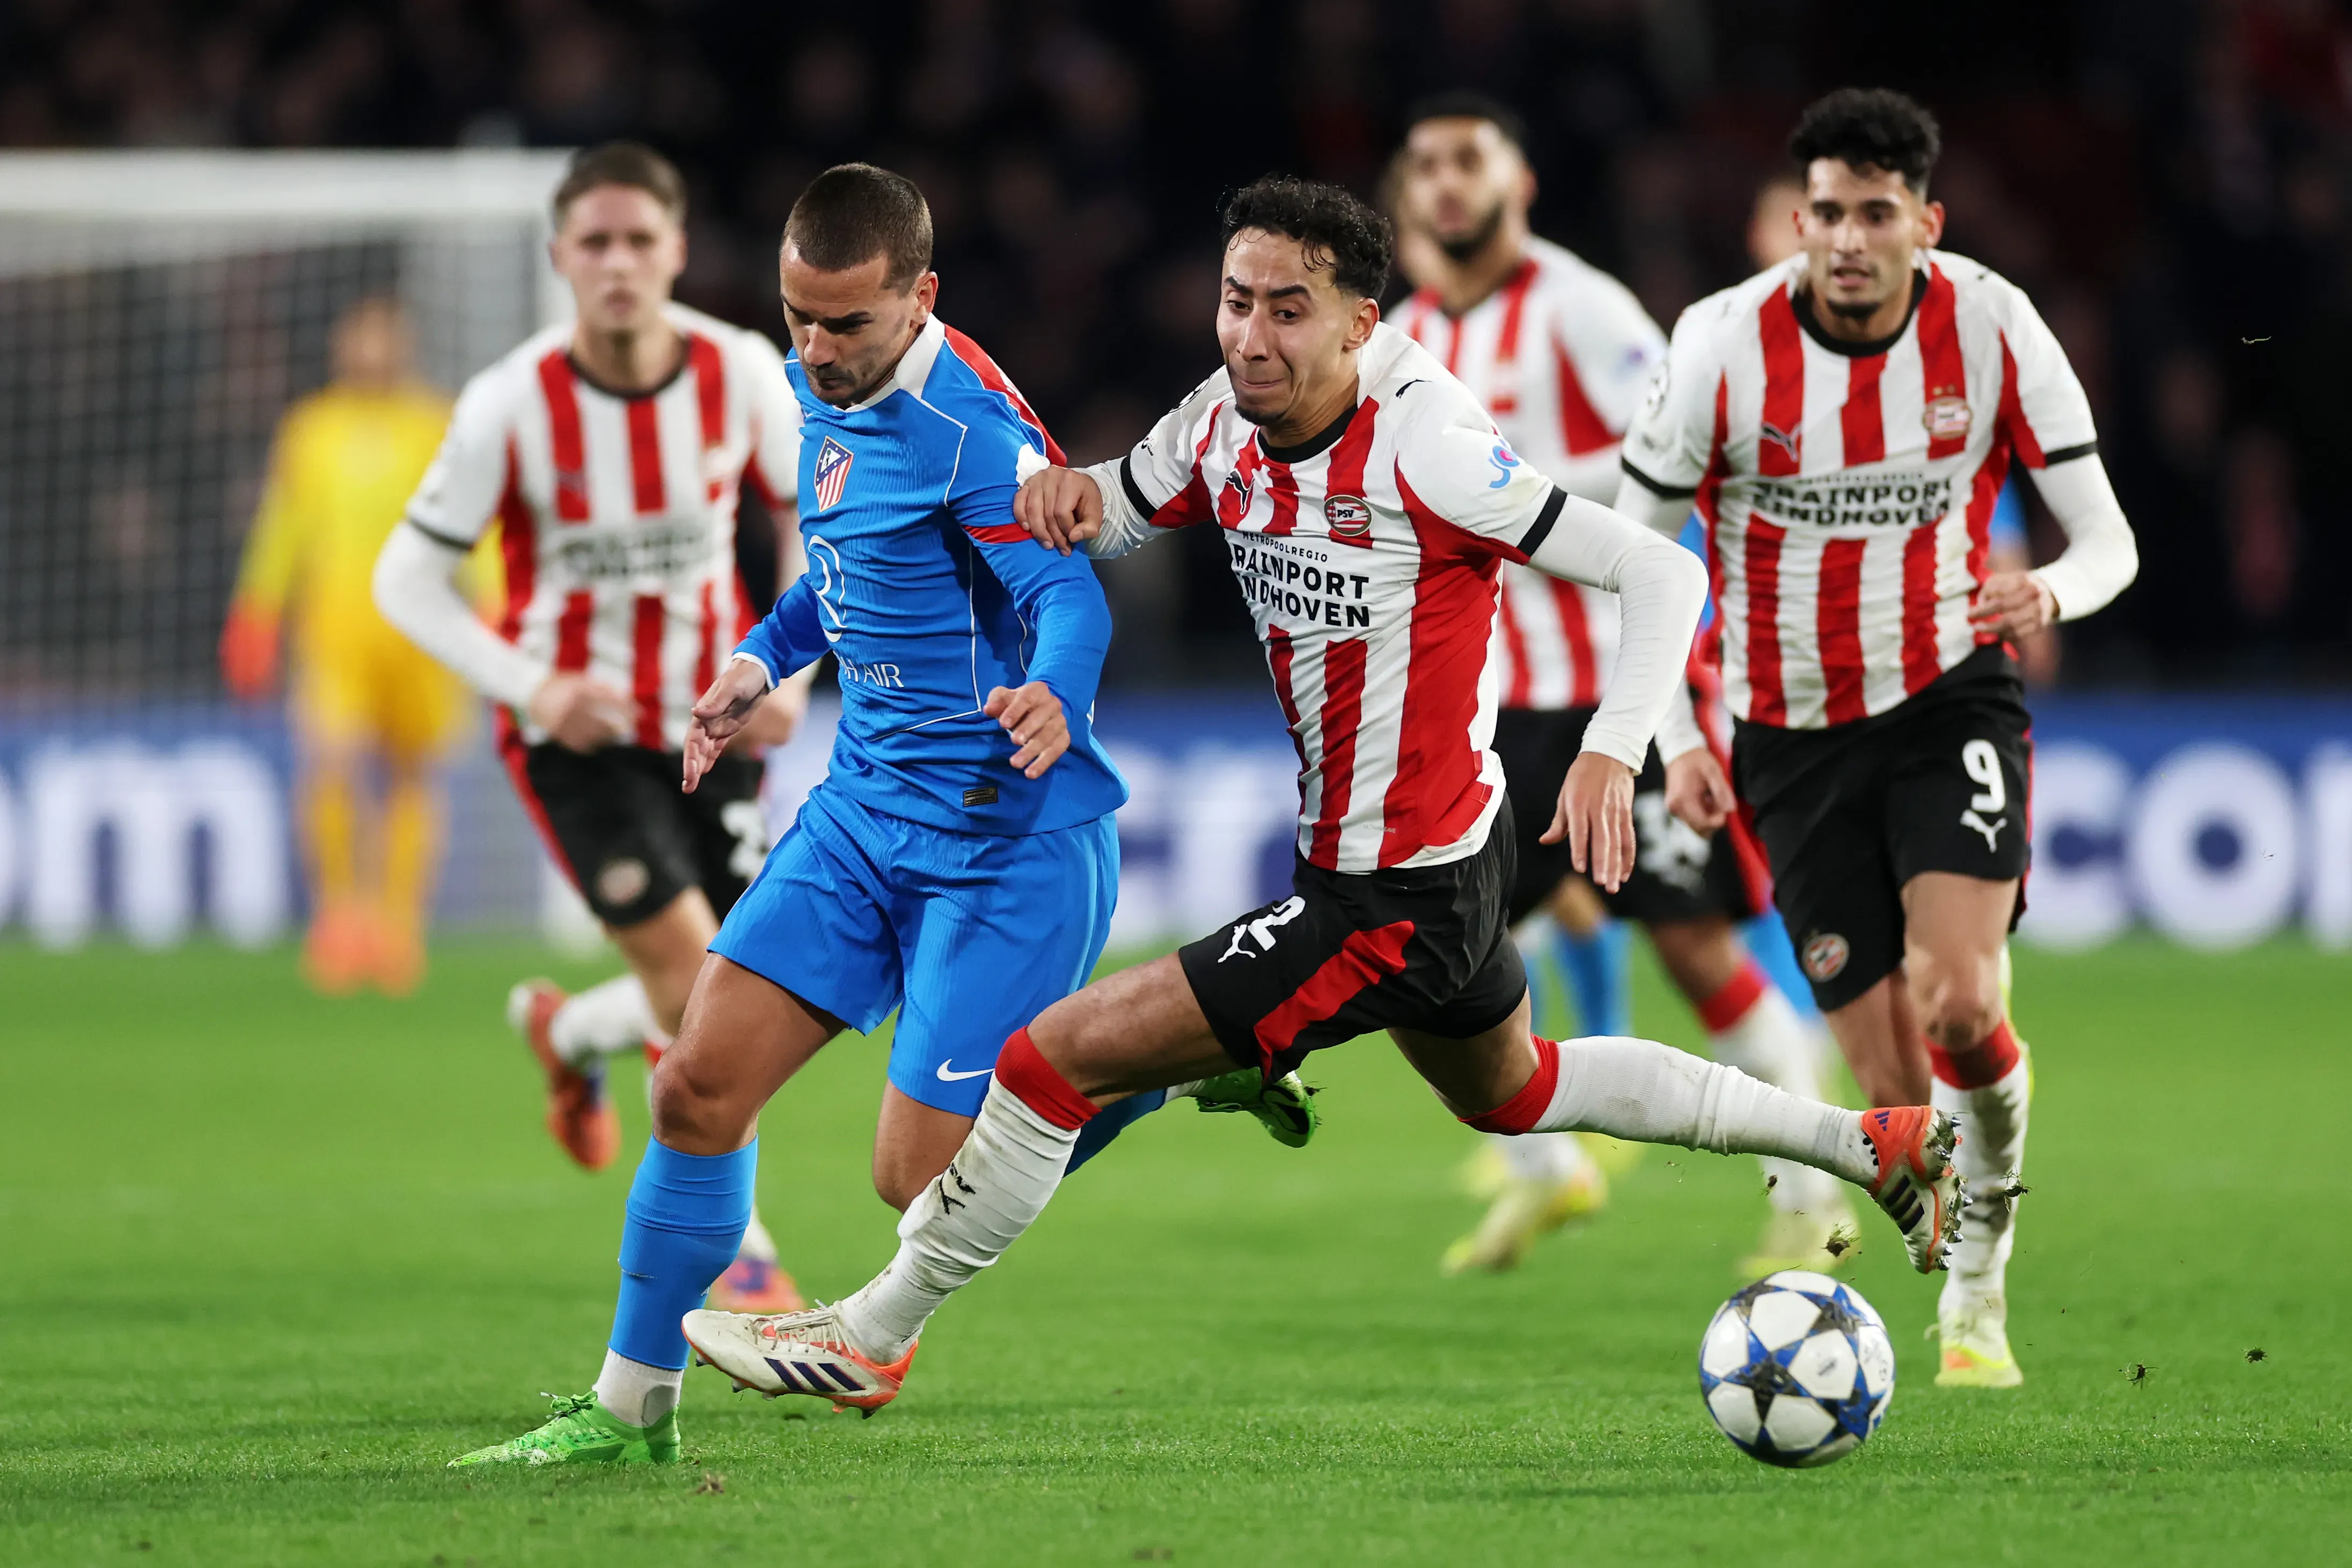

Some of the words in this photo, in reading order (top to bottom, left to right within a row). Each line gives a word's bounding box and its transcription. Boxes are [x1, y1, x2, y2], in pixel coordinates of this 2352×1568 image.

[1337, 509, 1354, 518] PSV
[1242, 531, 1328, 562] METROPOOLREGIO
[1237, 572, 1369, 627] NDHOVEN
[833, 650, 859, 682] H
[862, 663, 905, 688] AIR
[1962, 738, 2006, 814] 9
[0, 736, 284, 952] m
[2027, 736, 2352, 954] co
[1247, 895, 1306, 951] 2
